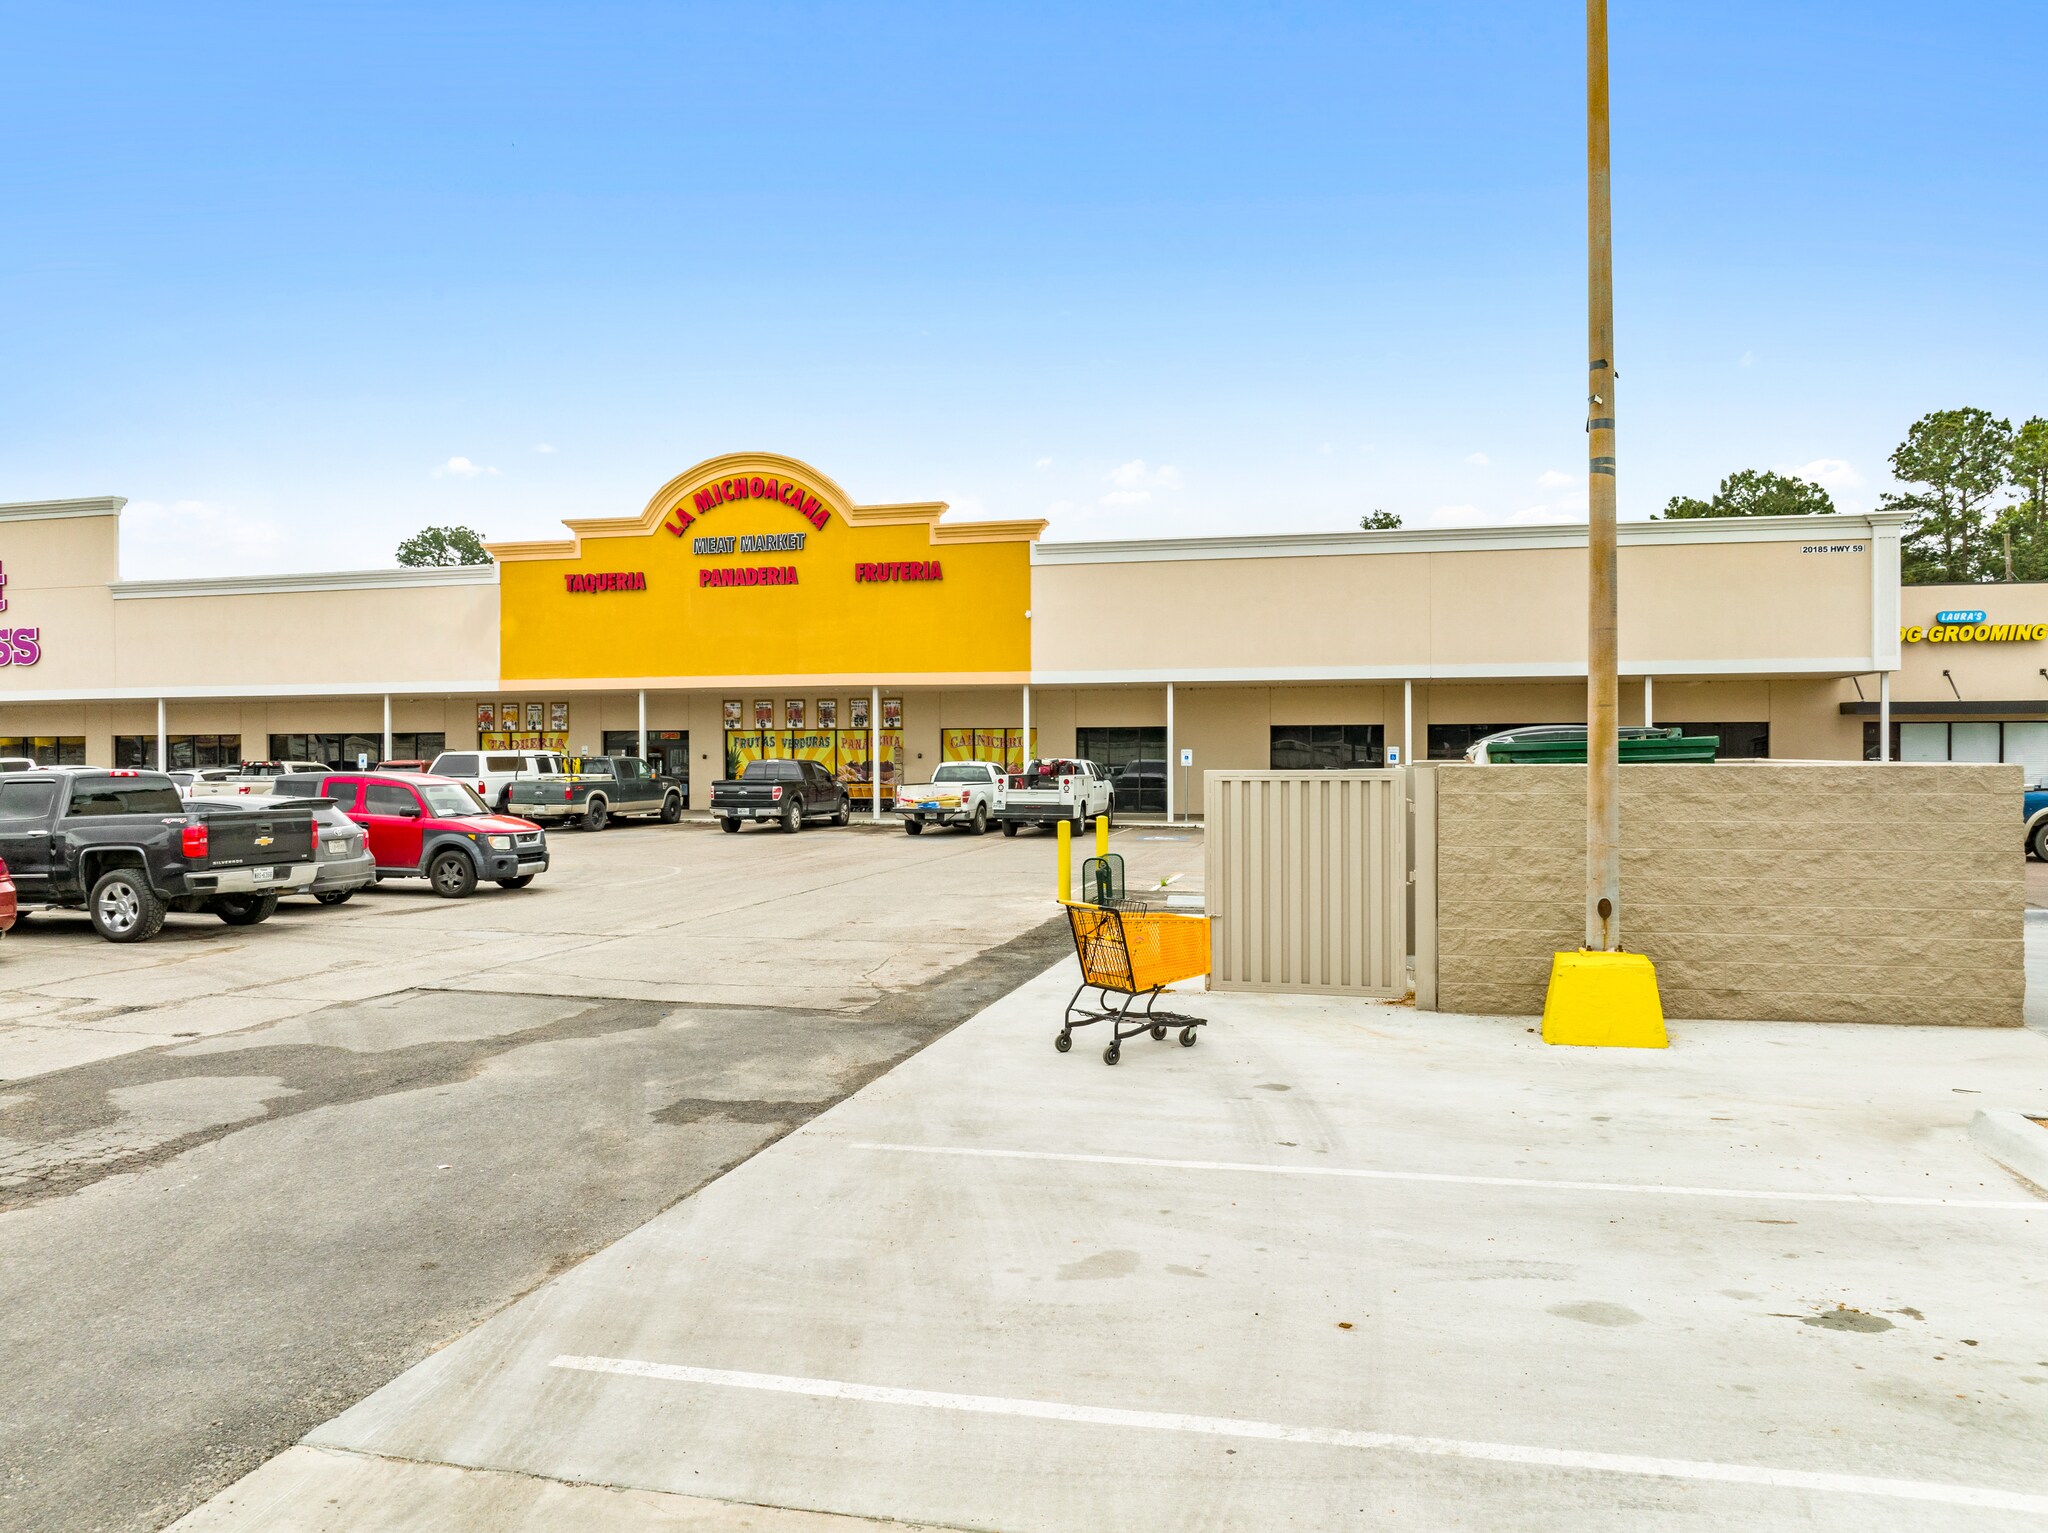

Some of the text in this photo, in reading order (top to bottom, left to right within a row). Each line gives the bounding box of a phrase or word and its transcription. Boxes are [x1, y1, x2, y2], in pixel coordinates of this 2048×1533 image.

[665, 477, 831, 537] LA MICHOACANA
[693, 533, 806, 555] MEAT MARKET
[700, 566, 798, 587] PANADERIA
[855, 561, 943, 582] FRUTERIA
[564, 572, 646, 593] TAQUERIA
[1941, 612, 1982, 621] LAURA'S
[1928, 624, 2048, 643] GROOMING
[734, 736, 830, 749] FRUTAS VERDURAS
[841, 734, 901, 750] PANARIA
[950, 733, 1024, 749] CARNICERI
